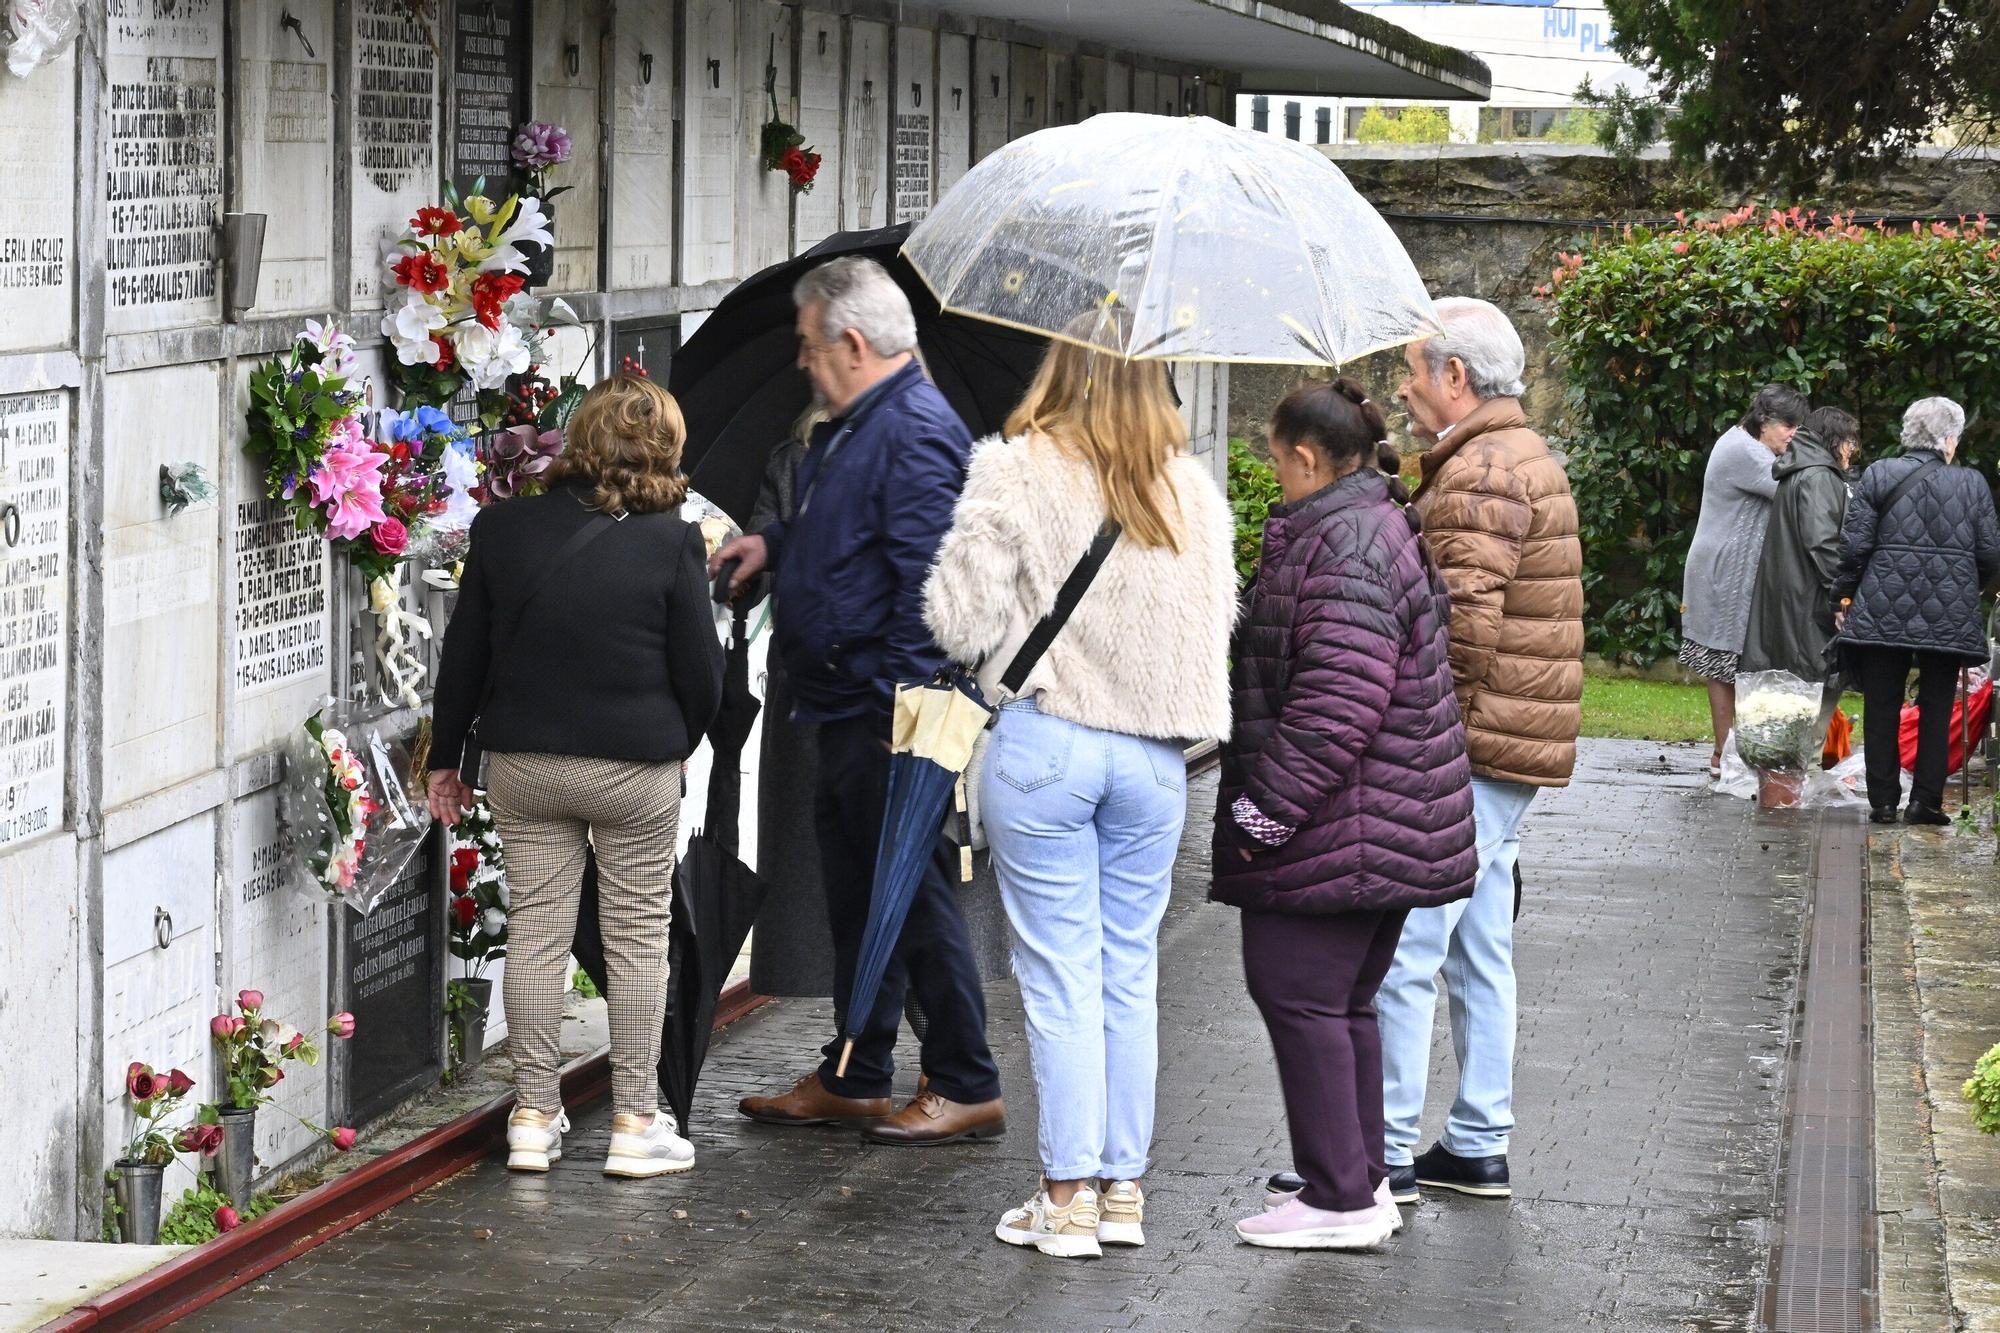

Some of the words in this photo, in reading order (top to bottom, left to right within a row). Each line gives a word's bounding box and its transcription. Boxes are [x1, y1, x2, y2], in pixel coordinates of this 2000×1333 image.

[31, 237, 64, 262] ARCAUZ
[10, 266, 27, 288] LOS
[41, 262, 63, 288] AÑOS
[167, 270, 183, 302] LOS
[28, 421, 57, 447] CARMEN
[18, 456, 55, 484] VILLAMOR
[22, 584, 46, 614] RUIZ
[247, 574, 273, 604] PABLO
[274, 567, 302, 598] PRIETO
[302, 563, 322, 591] ROJO
[285, 595, 298, 620] LOS
[307, 586, 325, 615] AÑOS
[35, 608, 58, 641] AÑOS
[249, 631, 275, 659] DANIEL
[277, 623, 302, 651] PRIETO
[303, 618, 321, 645] ROJO
[282, 652, 296, 677] LOS
[306, 643, 324, 671] AÑOS
[242, 869, 276, 905] RUESGAS
